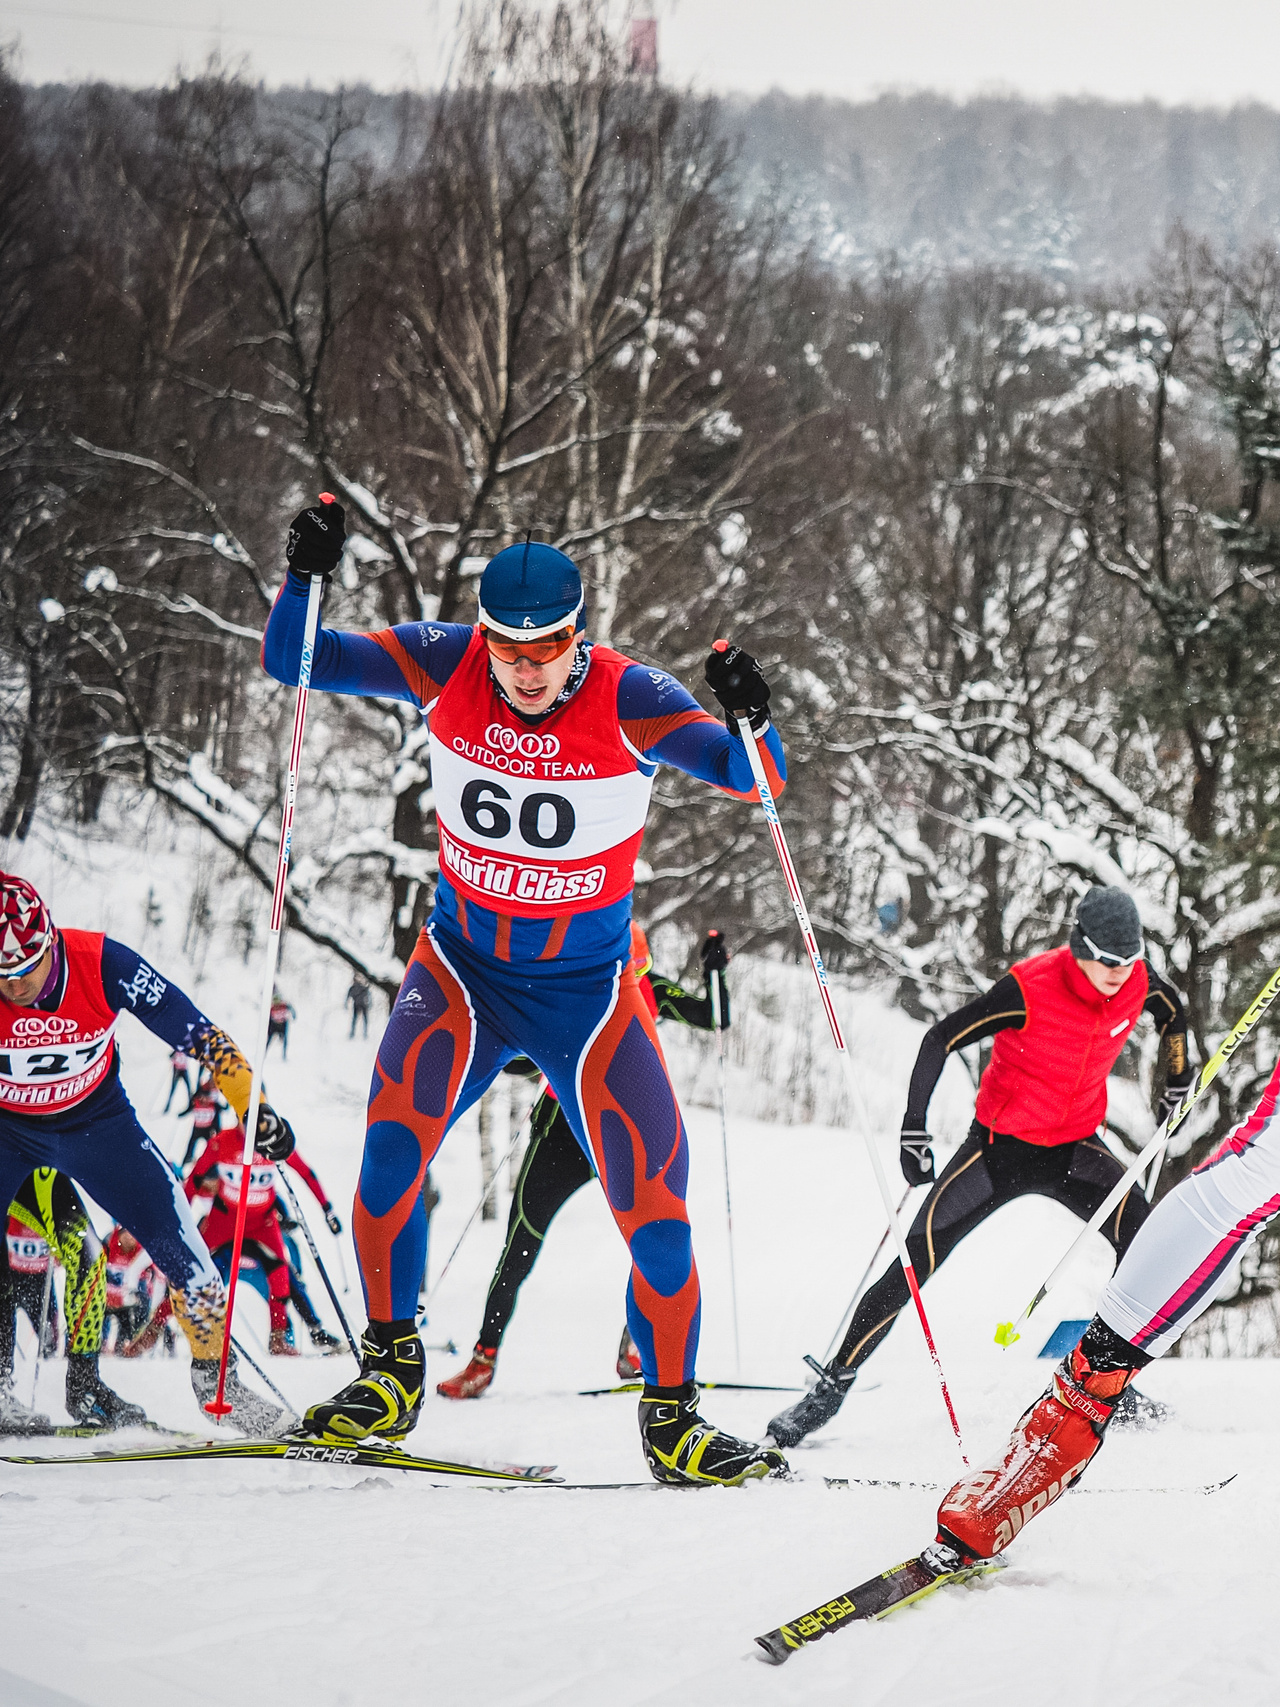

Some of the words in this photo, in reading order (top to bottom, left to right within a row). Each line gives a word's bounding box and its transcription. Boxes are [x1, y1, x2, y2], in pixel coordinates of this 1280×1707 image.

[453, 737, 535, 776] OUTDOOR
[542, 762, 596, 777] TEAM
[461, 779, 576, 848] 60
[443, 836, 514, 894] World
[516, 868, 600, 900] Class
[1063, 1386, 1106, 1424] alpina
[283, 1447, 359, 1464] FISCHER
[793, 1595, 856, 1637] FISCHER
